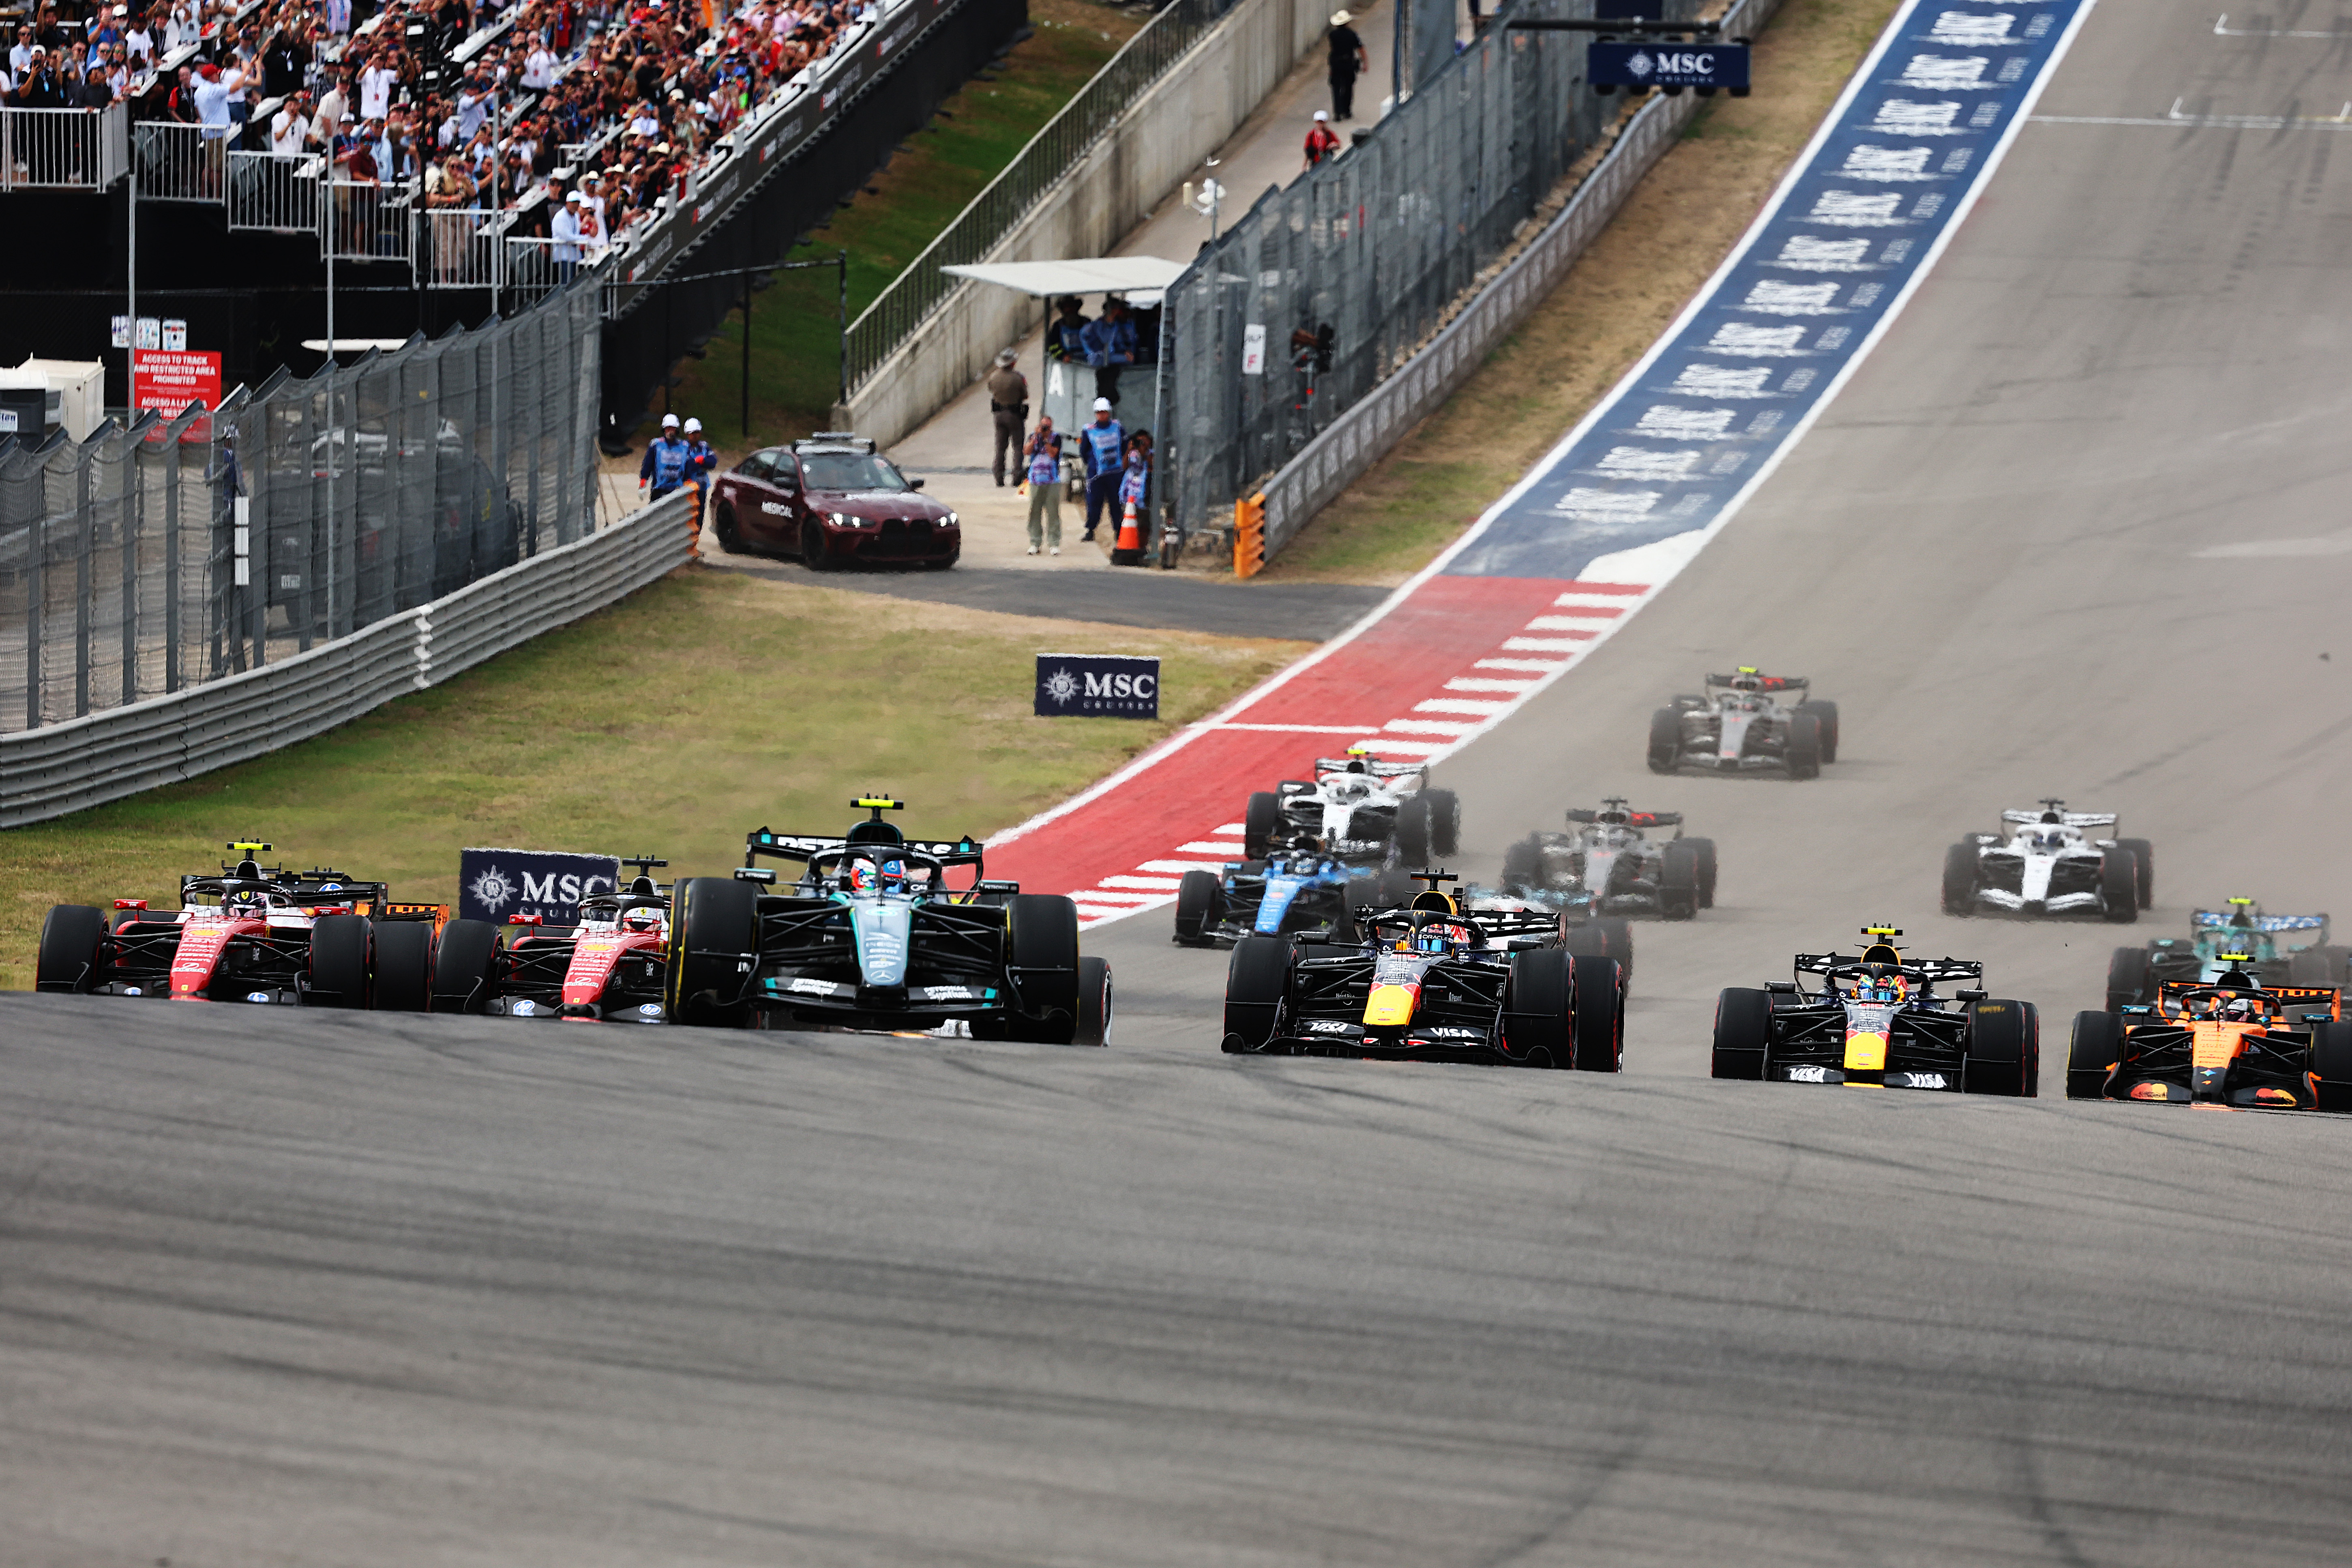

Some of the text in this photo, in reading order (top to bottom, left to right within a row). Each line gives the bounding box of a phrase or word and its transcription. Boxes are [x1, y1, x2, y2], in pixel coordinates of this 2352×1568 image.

[1656, 52, 1715, 75] MSC
[142, 354, 208, 365] ACCESS TO TRACK
[1248, 354, 1257, 368] F
[134, 364, 216, 376] AND RESTRICTED AREA
[153, 375, 197, 385] PROHIBITED
[1048, 363, 1064, 397] A
[142, 397, 170, 407] ACCESO
[761, 501, 793, 519] MEDICAL
[1083, 671, 1155, 699] MSC
[521, 871, 612, 905] MSC
[793, 978, 839, 989] PETRONAS
[927, 991, 973, 1000] Syntium
[641, 1004, 660, 1015] hp
[1310, 1022, 1349, 1032] VISA
[1430, 1027, 1475, 1038] VISA
[1789, 1068, 1826, 1083] VISA
[1904, 1072, 1947, 1089] VISA
